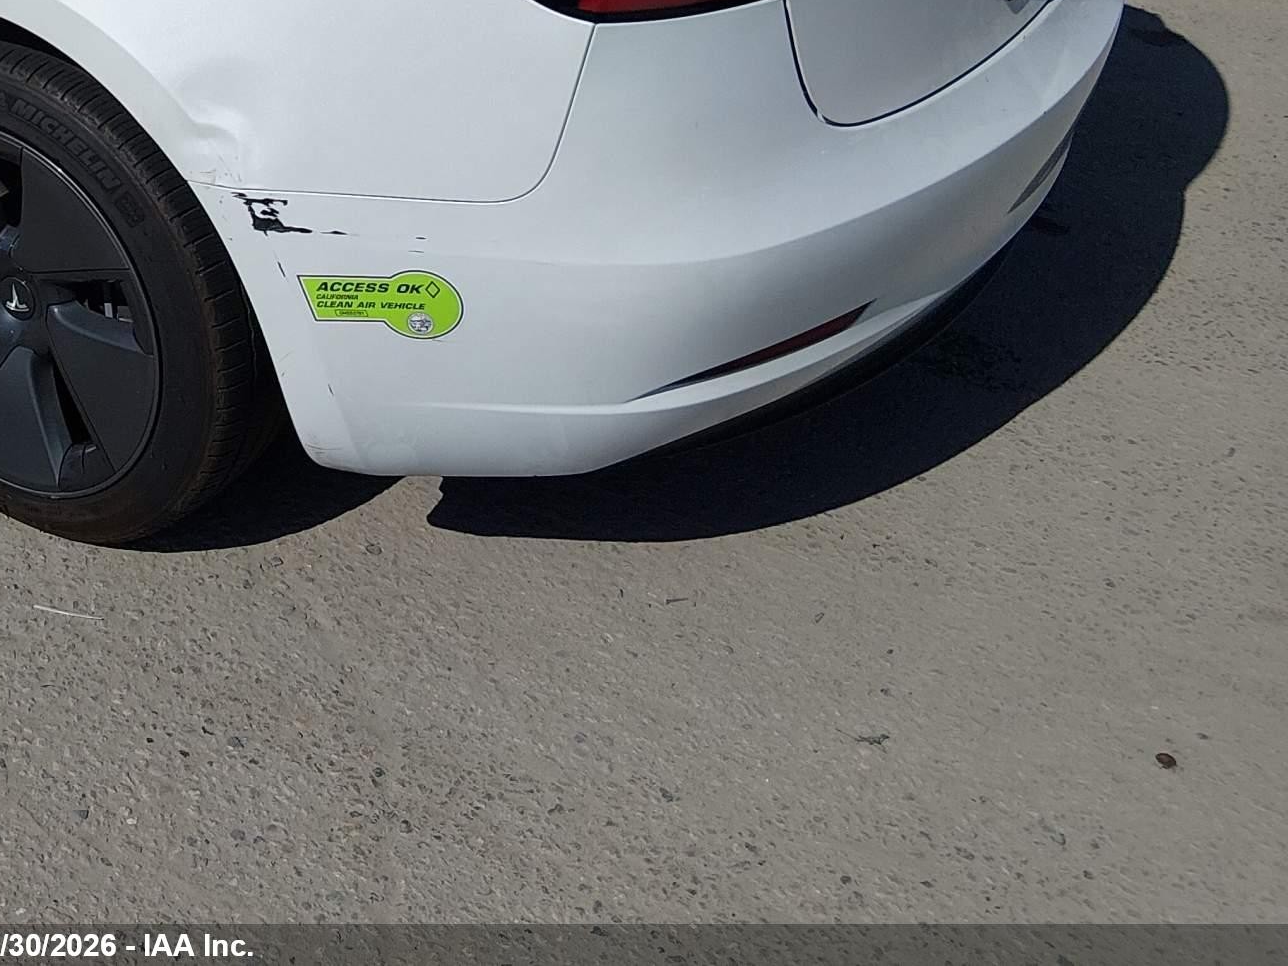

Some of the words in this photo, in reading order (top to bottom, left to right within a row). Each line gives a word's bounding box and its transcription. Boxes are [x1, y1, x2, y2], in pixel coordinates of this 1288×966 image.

[9, 97, 122, 191] MICHELIN
[316, 282, 390, 293] ACCESS
[396, 283, 425, 294] OK
[316, 300, 353, 308] CLEAN
[357, 301, 376, 309] AIR
[380, 302, 426, 310] VEHICLE
